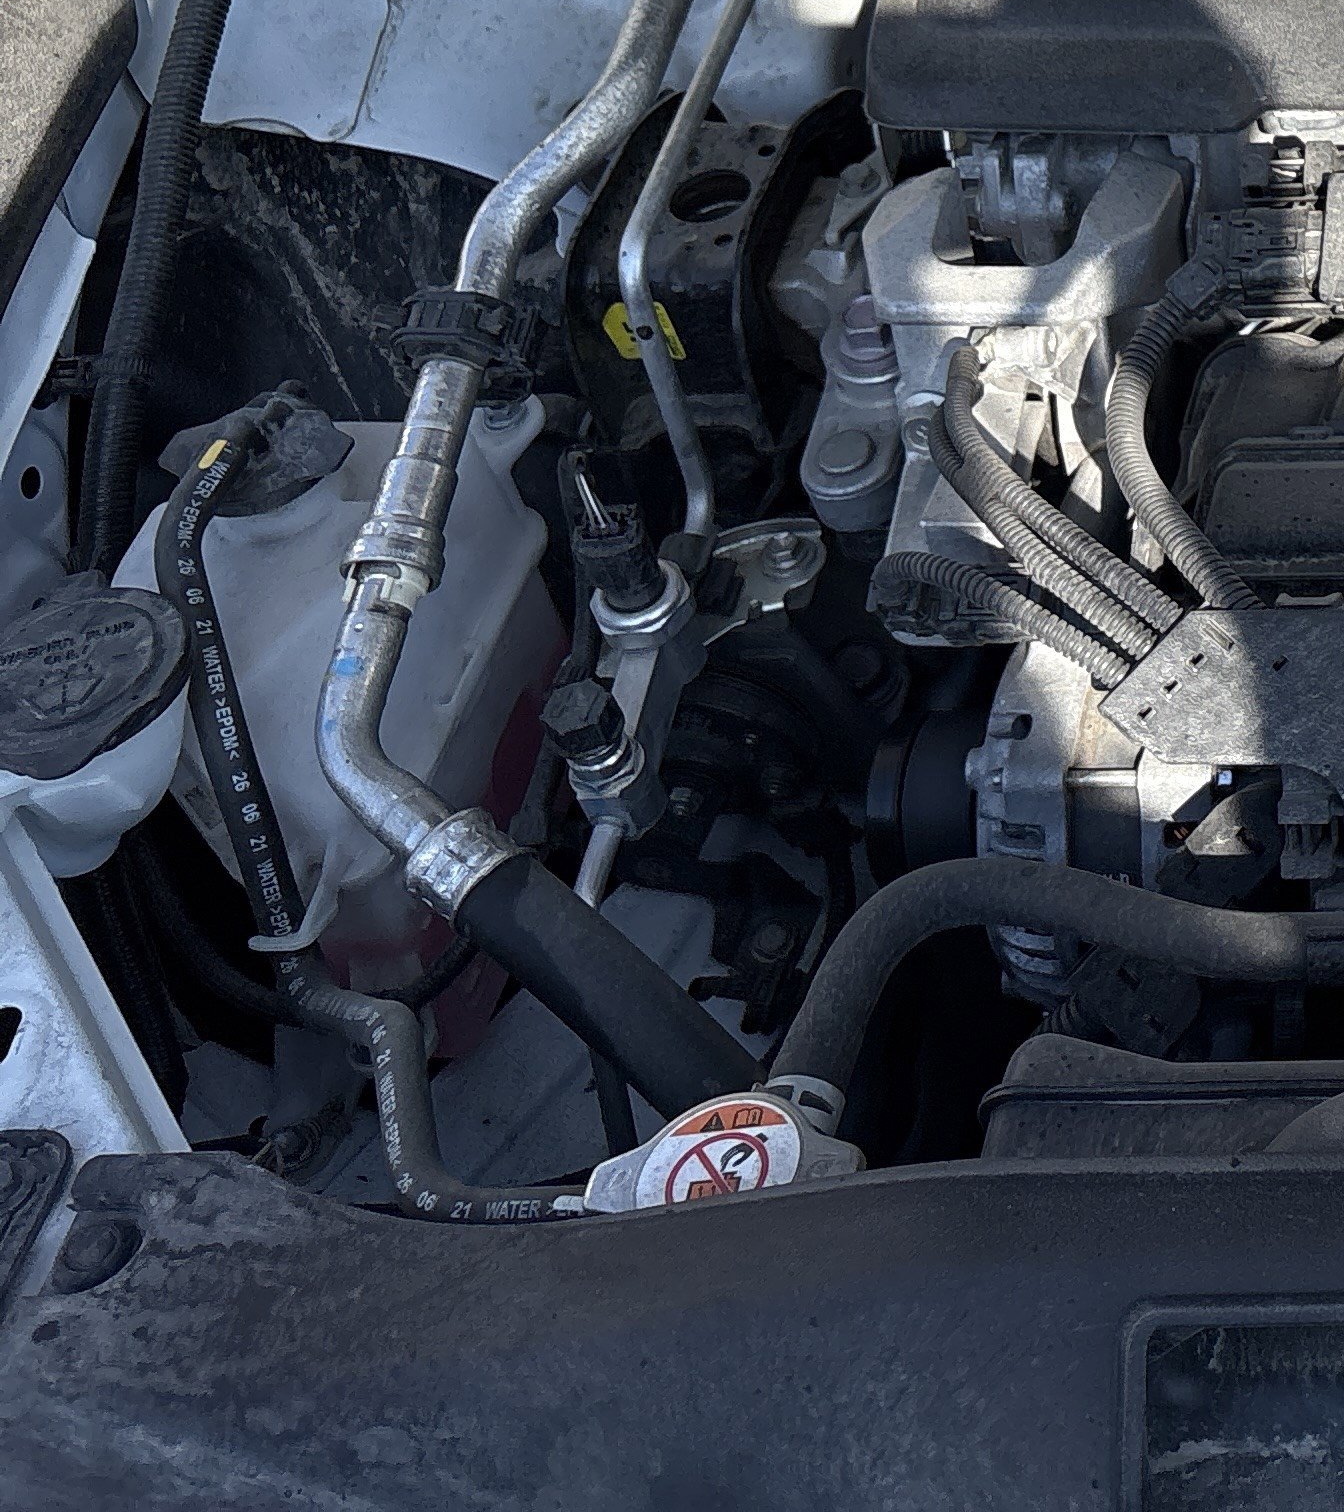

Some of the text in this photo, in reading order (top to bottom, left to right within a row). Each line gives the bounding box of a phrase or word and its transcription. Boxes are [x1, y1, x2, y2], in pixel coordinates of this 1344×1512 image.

[194, 461, 230, 500] WATER
[195, 619, 214, 635] 21
[202, 644, 226, 695] WATER
[214, 697, 240, 760] >EPDM<
[231, 771, 250, 793] 26
[241, 802, 261, 824] 06
[250, 835, 269, 853] 21
[256, 858, 282, 909] WATER
[269, 904, 293, 937] >EPD
[396, 1172, 414, 1195] 26
[416, 1189, 441, 1212] 06
[450, 1200, 474, 1219] 21
[484, 1199, 542, 1221] WATER
